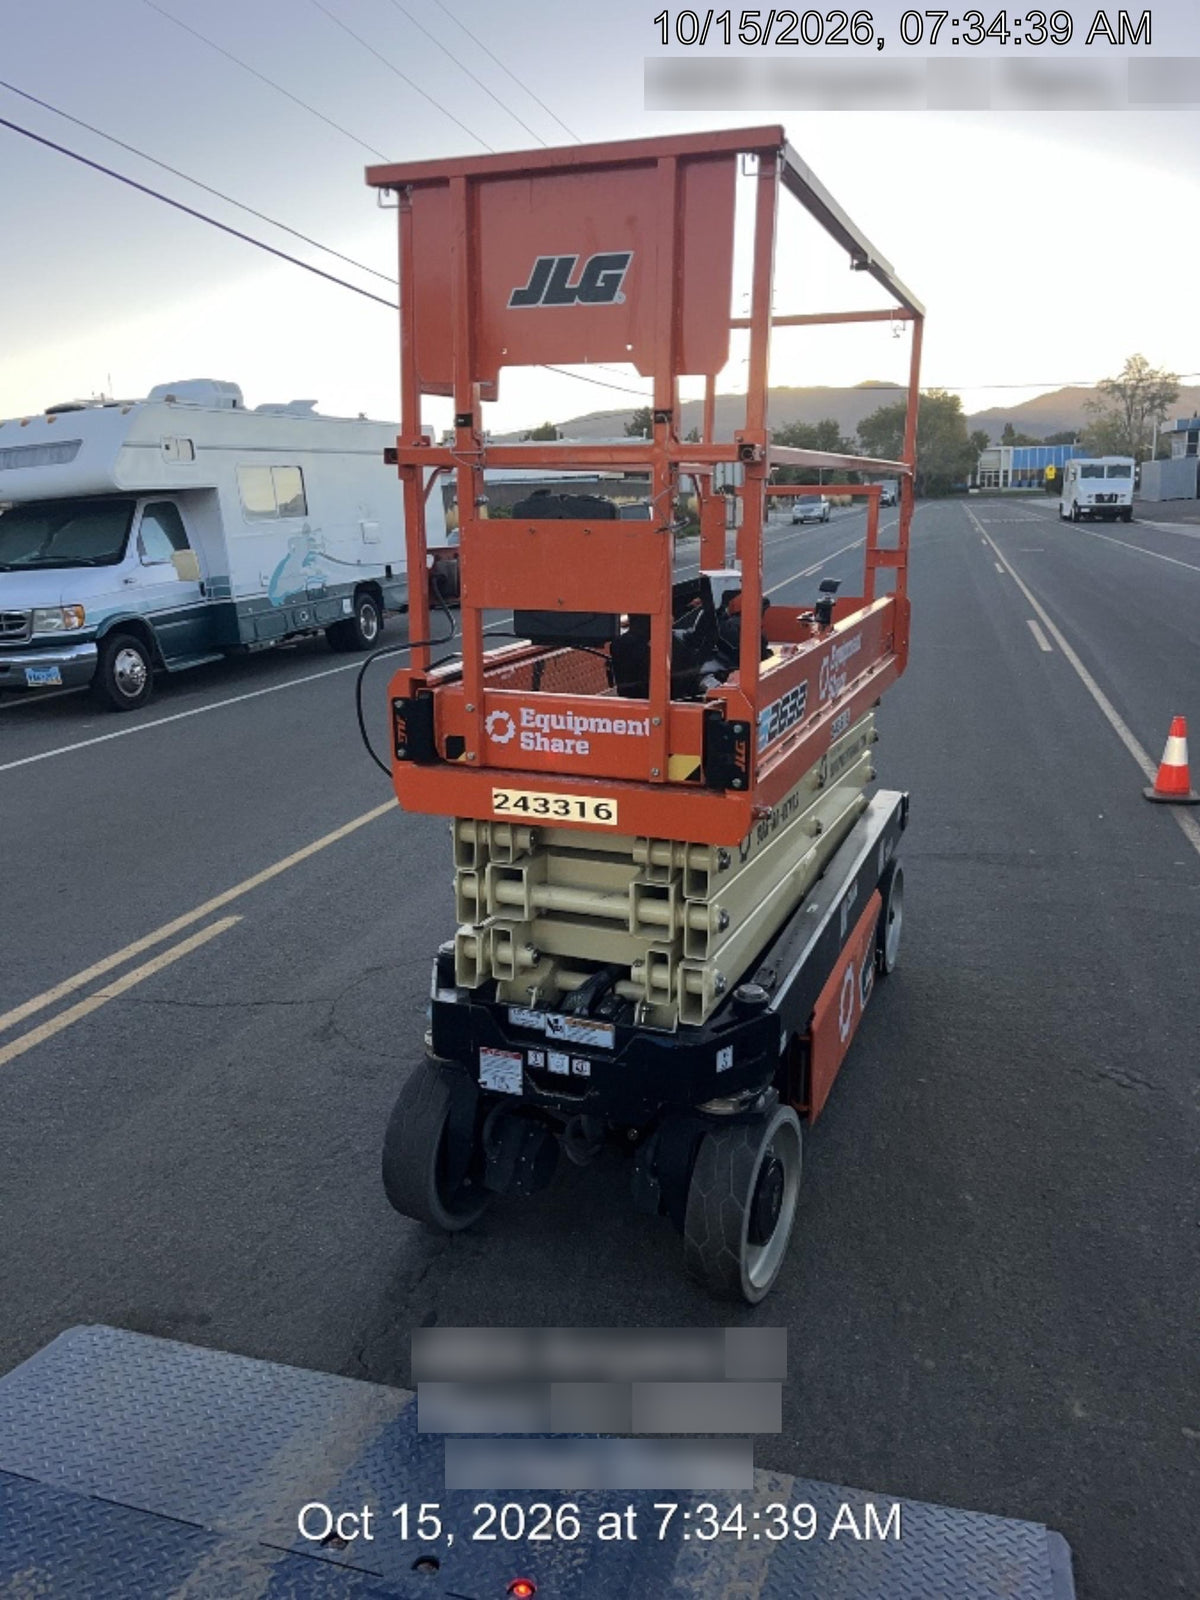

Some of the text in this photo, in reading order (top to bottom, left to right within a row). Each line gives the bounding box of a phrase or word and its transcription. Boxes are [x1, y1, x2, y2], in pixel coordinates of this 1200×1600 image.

[506, 251, 635, 309] JLG
[520, 731, 590, 755] Share
[493, 793, 613, 821] 243316
